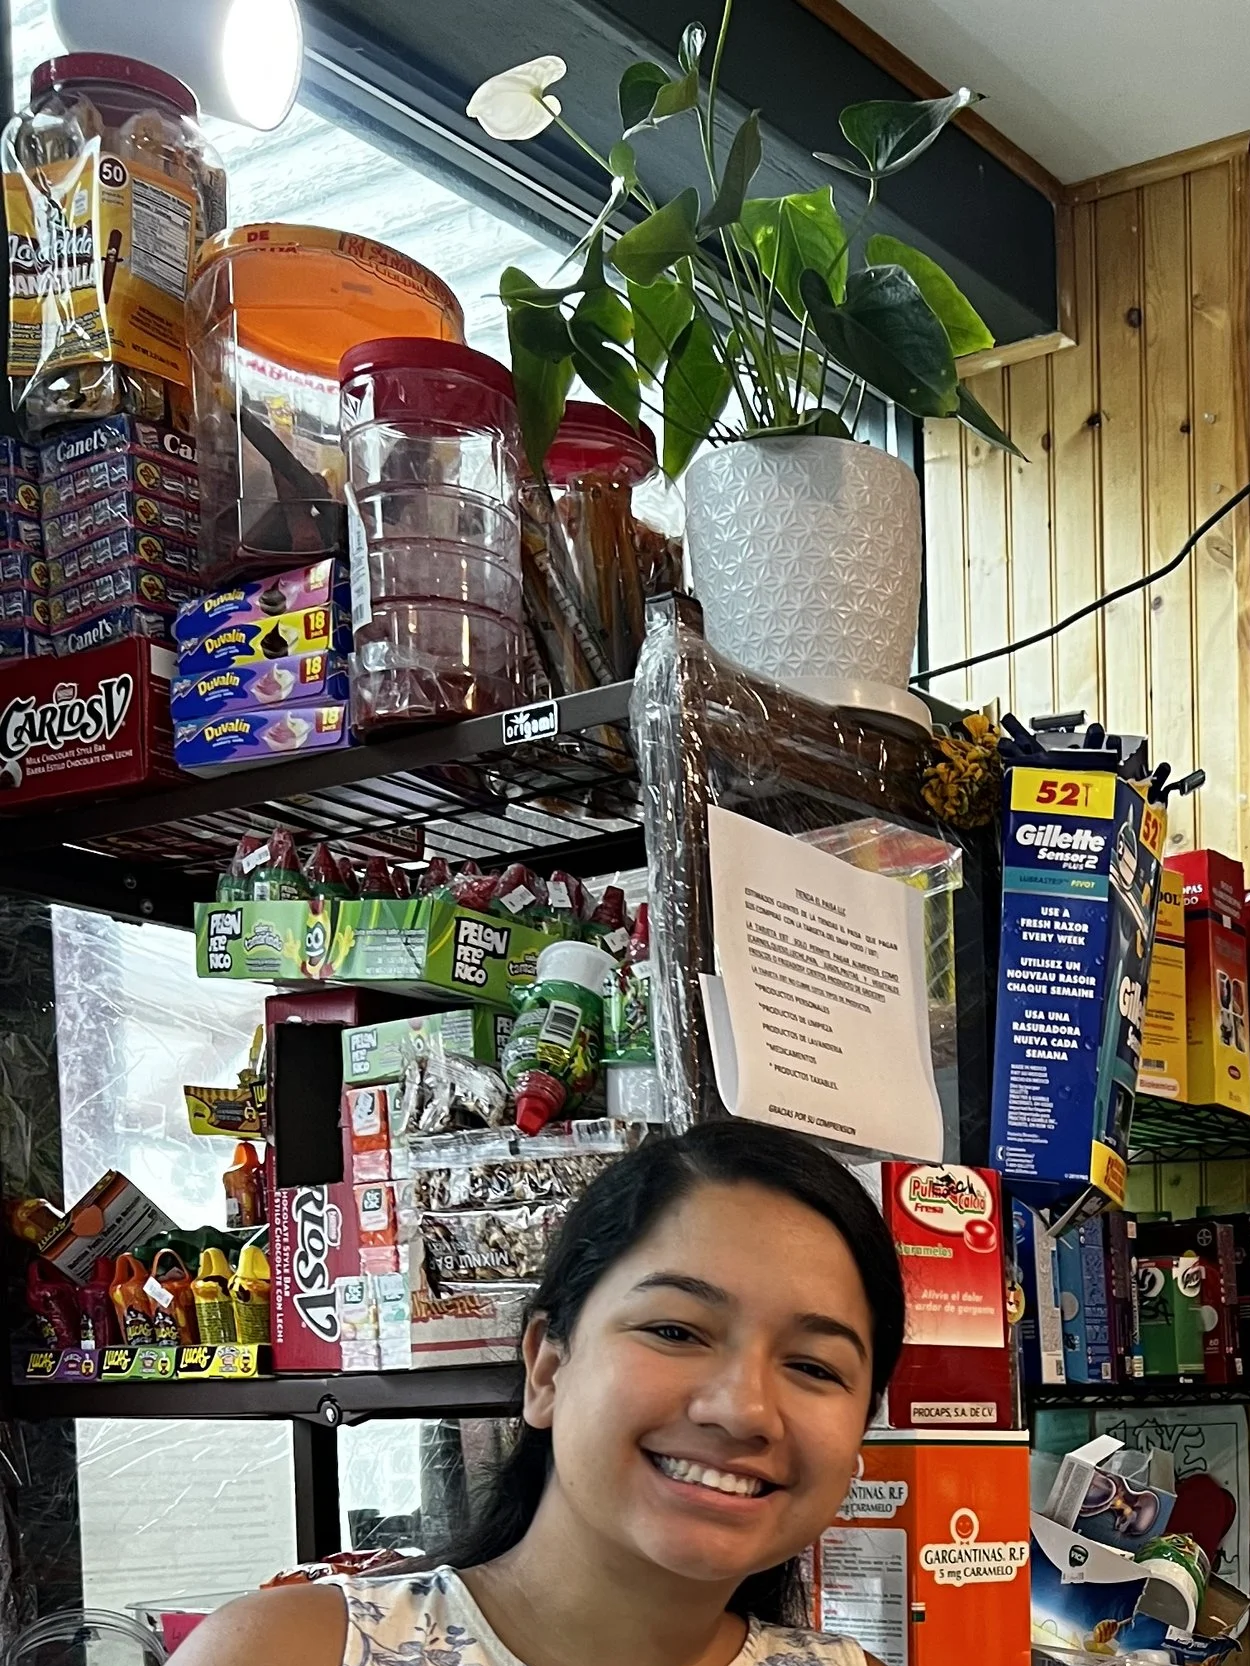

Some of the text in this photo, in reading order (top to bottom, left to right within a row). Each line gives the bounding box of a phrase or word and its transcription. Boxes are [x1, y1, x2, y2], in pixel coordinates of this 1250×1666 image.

[102, 163, 123, 181] 50
[56, 427, 108, 462] Canel's
[307, 610, 326, 631] 18
[204, 722, 251, 742] Duvalin
[1035, 781, 1081, 807] 52
[1015, 823, 1105, 852] Gillette
[1041, 907, 1071, 918] USE A
[1020, 918, 1089, 934] FRESH RAZOR
[1022, 931, 1086, 946] EVERY WEEK
[208, 951, 232, 971] RICO
[1024, 1009, 1070, 1022] USA UNA
[1012, 1021, 1081, 1037] RASURADORA
[1013, 1034, 1079, 1049] NUEVA CADA
[1025, 1048, 1069, 1061] SEMANA
[180, 1348, 211, 1369] LUCAS
[970, 1408, 980, 1418] DE
[939, 1565, 1013, 1581] 5 mg CARAMELO
